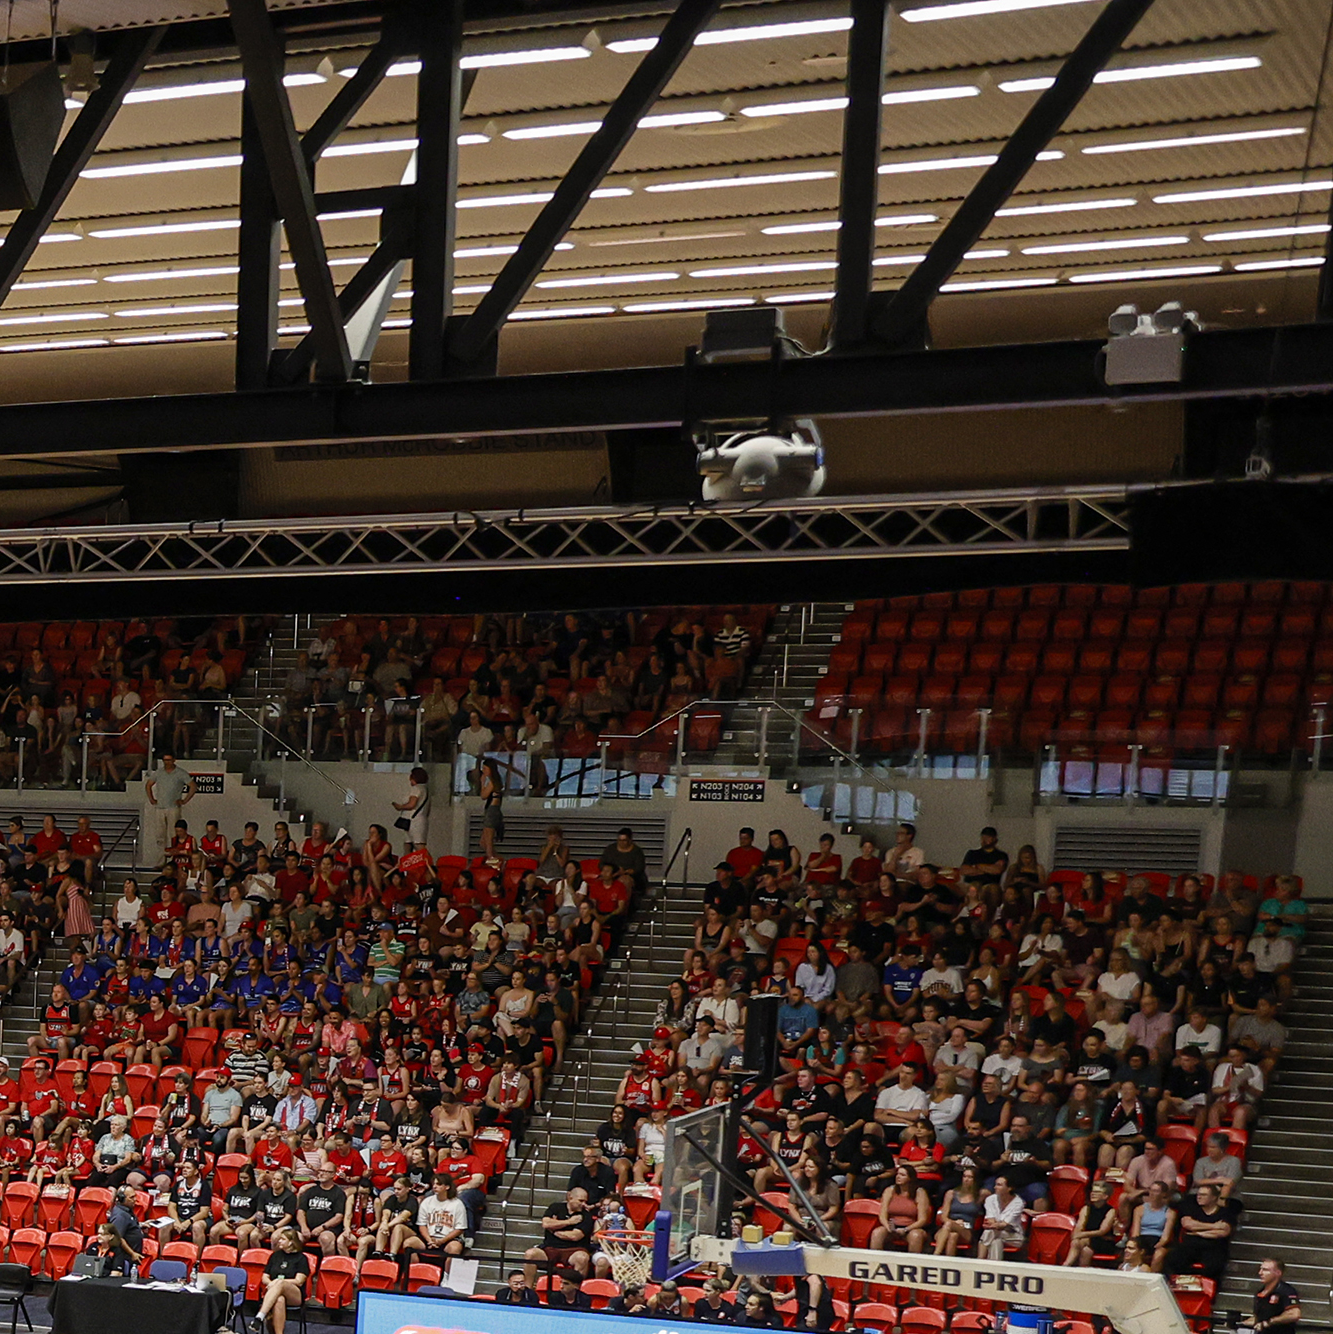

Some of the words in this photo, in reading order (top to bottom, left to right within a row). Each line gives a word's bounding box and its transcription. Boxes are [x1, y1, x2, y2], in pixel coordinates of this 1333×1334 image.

[398, 1125, 420, 1136] LYNX
[779, 1148, 800, 1158] LYNX
[848, 1260, 961, 1287] GARED
[973, 1271, 1045, 1296] PRO
